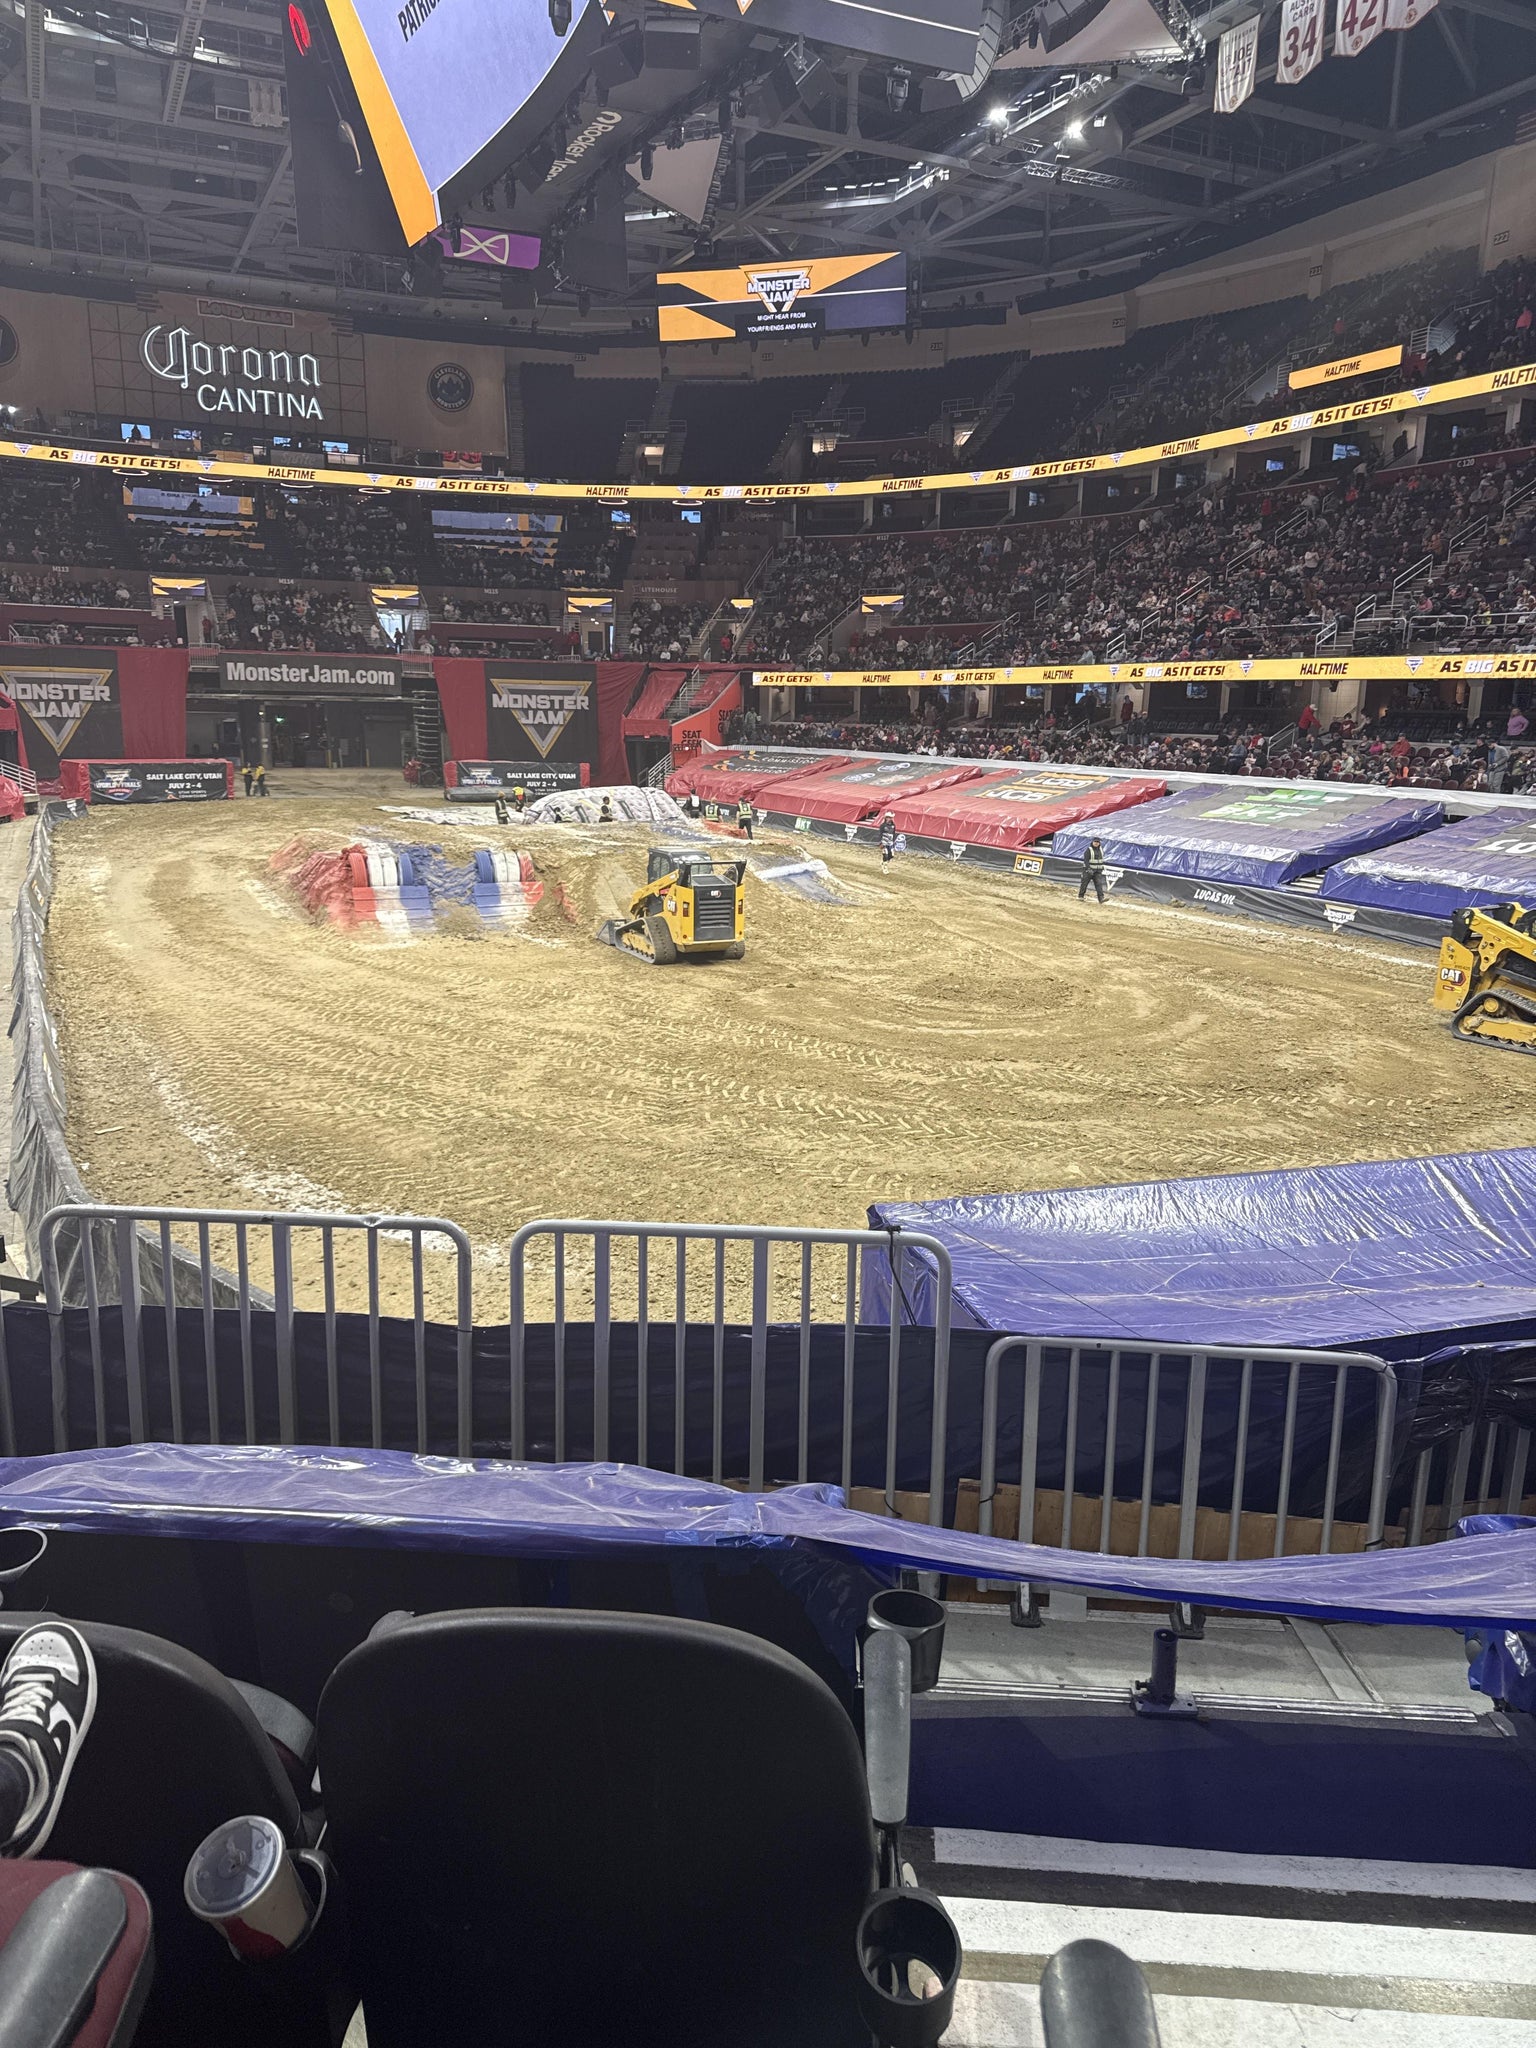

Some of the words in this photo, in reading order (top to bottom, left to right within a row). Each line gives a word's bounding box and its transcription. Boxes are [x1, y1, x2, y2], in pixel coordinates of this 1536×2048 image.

[1292, 3, 1315, 23] CARR
[1341, 0, 1380, 38] 42
[1283, 15, 1319, 68] 34
[1232, 41, 1254, 65] JOE
[566, 119, 615, 165] Rocket
[747, 277, 811, 293] MONSTER
[764, 289, 795, 303] JAM
[757, 313, 774, 321] MIGHT
[774, 312, 789, 320] HEAR
[790, 311, 807, 319] FROM
[797, 321, 817, 330] FAMILY
[140, 324, 323, 389] Corona
[434, 367, 466, 380] CLEVELAND
[1324, 360, 1363, 378] HALFTIME
[1491, 366, 1536, 389] HALFTI
[196, 384, 324, 421] CANTINA
[1270, 419, 1288, 434] AS
[1290, 414, 1313, 430] BIG
[1314, 409, 1332, 425] AS
[1334, 406, 1349, 421] IT
[1352, 397, 1394, 416] GETS!
[1161, 438, 1201, 458] HALFTIME
[49, 449, 69, 460] AS
[71, 449, 98, 463] BIG
[99, 454, 119, 466] AS
[121, 455, 137, 467] IT
[140, 457, 181, 470] GETS!
[267, 467, 316, 480] HALFTIME
[995, 469, 1011, 482] AS
[1012, 467, 1031, 480] BIG
[1032, 464, 1048, 477] AS
[1049, 462, 1062, 474] IT
[1062, 457, 1097, 472] GETS!
[395, 478, 413, 488] AS
[415, 479, 437, 489] BIG
[438, 480, 456, 490] AS
[457, 481, 472, 490] IT
[473, 482, 510, 492] GETS!
[585, 486, 630, 496] HALFTIME
[704, 487, 721, 497] AS
[722, 487, 742, 497] BIG
[744, 487, 760, 496] AS
[761, 487, 775, 496] IT
[776, 486, 810, 495] GETS!
[881, 478, 924, 491] HALFTIME
[640, 586, 678, 594] LITEHOUSE
[226, 662, 395, 686] MonsterJam.com
[1130, 667, 1144, 677] AS
[1145, 666, 1163, 677] BIG
[1164, 666, 1179, 677] AS
[1179, 666, 1191, 676] IT
[1193, 665, 1226, 676] GETS!
[1299, 662, 1349, 676] HALFTIME
[1440, 660, 1463, 672] AS
[1464, 660, 1495, 673] BIG
[1495, 660, 1520, 672] AS
[762, 675, 774, 683] AS
[775, 675, 785, 683] IT
[786, 675, 813, 683] GETS!
[862, 673, 891, 683] HALFTIME
[932, 673, 942, 682] AS
[955, 672, 965, 681] AS
[965, 672, 973, 681] IT
[974, 671, 996, 681] GETS!
[1042, 669, 1074, 680] HALFTIME
[0, 683, 111, 702] MONSTER
[32, 701, 81, 718] JAM
[492, 693, 590, 711] MONSTER
[520, 709, 565, 725] JAM
[682, 729, 702, 739] SEAT
[986, 789, 1052, 800] JCB
[796, 820, 812, 831] BKT
[1017, 858, 1041, 872] JCB
[1193, 888, 1221, 904] LUCAS
[1221, 893, 1236, 905] OIL
[1440, 967, 1463, 983] CAT
